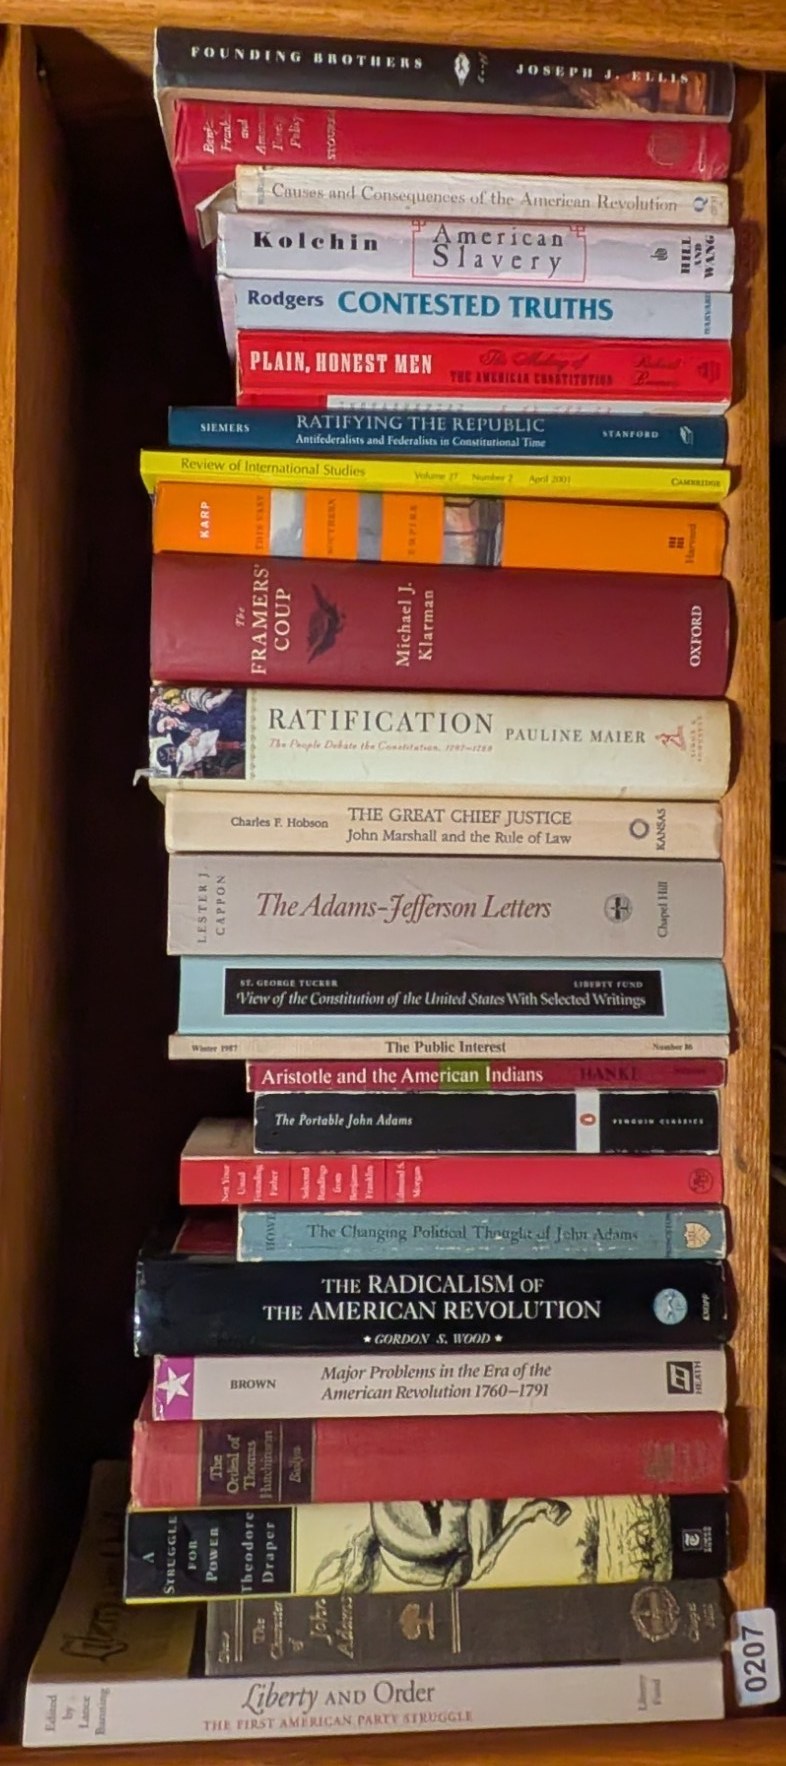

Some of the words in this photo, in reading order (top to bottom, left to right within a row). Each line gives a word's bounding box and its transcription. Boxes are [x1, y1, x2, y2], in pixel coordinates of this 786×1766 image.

[191, 47, 301, 63] FOUNDING
[313, 52, 423, 69] BROTHERS
[516, 64, 593, 79] JOSEPH
[604, 68, 620, 79] J.
[632, 71, 689, 84] ELLIS
[272, 183, 324, 199] Causes
[328, 179, 355, 199] and
[361, 184, 465, 205] Consequences
[470, 191, 487, 205] of
[491, 191, 514, 206] the
[519, 192, 590, 208] American
[597, 194, 677, 212] Revolution
[253, 231, 378, 251] Kolchin
[432, 223, 563, 247] American
[432, 244, 561, 278] Slavery
[680, 236, 691, 274] HILL
[704, 235, 715, 279] WANG
[247, 290, 324, 310] Rodgers
[338, 291, 500, 317] CONTESTED
[509, 295, 613, 321] TRUTHS
[250, 351, 310, 374] PLAIN,
[316, 352, 388, 373] HONEST
[395, 354, 432, 374] MEN
[450, 371, 471, 383] THE
[476, 372, 529, 384] AMERICAN
[534, 373, 613, 386] CONSTITUTION
[200, 423, 250, 433] SIEMERS
[297, 415, 402, 431] RATIFYING
[407, 416, 446, 431] THE
[452, 417, 545, 433] REPUBLIC
[602, 430, 659, 439] STANFORD
[296, 434, 364, 445] Antifederalists
[367, 435, 385, 446] and
[387, 435, 438, 446] Federalists
[440, 436, 450, 446] in
[452, 436, 520, 447] Constitutional
[522, 437, 546, 448] Time
[181, 458, 224, 471] Review
[229, 459, 242, 472] of
[244, 460, 320, 476] International
[323, 463, 366, 477] Studies
[200, 501, 211, 539] KARP
[398, 582, 415, 594] J.
[236, 606, 245, 628] The
[274, 588, 290, 652] COUP
[418, 590, 434, 661] Klarman
[396, 596, 411, 667] Michael
[689, 605, 702, 667] OXFORD
[269, 708, 493, 734] RATIFICATION
[505, 728, 583, 742] PAULINE
[590, 730, 646, 744] MAIER
[231, 817, 270, 828] Charles
[274, 818, 283, 828] F.
[287, 818, 329, 829] Hobson
[347, 807, 382, 822] THE
[388, 808, 445, 823] GREAT
[451, 809, 501, 823] CHIEF
[504, 810, 572, 827] JUSTICE
[346, 830, 378, 843] John
[382, 830, 437, 842] Marshall
[441, 831, 466, 843] and
[470, 831, 490, 843] the
[495, 831, 523, 844] Rule
[527, 832, 543, 844] of
[546, 832, 572, 844] Law
[656, 808, 667, 851] KANSAS
[657, 881, 668, 900] Hill
[197, 885, 208, 943] LESTER
[215, 874, 226, 936] CAPPON
[257, 892, 298, 917] The
[300, 893, 477, 924] Adams-Jefferson
[482, 894, 552, 919] Letters
[657, 901, 668, 938] Chapel
[240, 980, 254, 988] ST.
[256, 980, 296, 988] GEORGE
[299, 980, 338, 988] TUCKER
[573, 980, 614, 989] LIBERTY
[616, 981, 643, 989] FUND
[236, 991, 270, 1004] View
[272, 991, 286, 1008] of
[289, 991, 307, 1005] the
[310, 992, 384, 1006] Constitution
[387, 992, 402, 1008] of
[403, 992, 422, 1006] the
[424, 992, 466, 1006] United
[467, 992, 505, 1006] States
[506, 992, 538, 1006] With
[540, 992, 590, 1006] Selected
[591, 993, 646, 1009] Writings
[191, 1045, 217, 1053] Winter
[385, 1041, 410, 1053] The
[414, 1040, 455, 1053] Public
[459, 1041, 506, 1053] Interest
[261, 1069, 332, 1085] Aristotle
[336, 1068, 366, 1085] and
[372, 1068, 397, 1084] the
[400, 1067, 479, 1084] American
[486, 1066, 543, 1083] Indians
[275, 1113, 295, 1126] The
[298, 1112, 344, 1127] Portable
[346, 1113, 373, 1129] John
[376, 1114, 413, 1126] Adams
[307, 1224, 336, 1238] The
[341, 1225, 408, 1242] Changing
[413, 1225, 467, 1239] Political
[472, 1225, 532, 1244] Thought
[553, 1226, 588, 1244] John
[593, 1227, 639, 1241] Adams
[322, 1278, 361, 1294] THE
[368, 1274, 513, 1294] RADICALISM
[520, 1278, 544, 1294] OF
[262, 1305, 302, 1321] THE
[308, 1301, 435, 1320] AMERICAN
[443, 1300, 601, 1320] REVOLUTION
[374, 1333, 430, 1345] GORDON
[436, 1333, 448, 1344] S.
[453, 1333, 491, 1344] WOOD
[321, 1366, 366, 1384] Major
[369, 1364, 437, 1380] Problems
[440, 1364, 454, 1378] in
[457, 1364, 480, 1378] the
[483, 1364, 510, 1378] Era
[512, 1362, 531, 1381] of
[533, 1362, 552, 1377] the
[230, 1379, 276, 1390] BROWN
[321, 1386, 392, 1400] American
[395, 1384, 471, 1400] Revolution
[227, 1433, 241, 1450] of
[209, 1454, 223, 1481] The
[226, 1452, 240, 1494] Ordeal
[243, 1440, 256, 1491] Thomas
[259, 1430, 273, 1499] Hutchinson
[142, 1552, 155, 1564] A
[163, 1515, 178, 1594] STRUGGLE
[188, 1540, 198, 1570] FOR
[206, 1527, 219, 1582] POWER
[241, 1512, 255, 1593] Theodore
[262, 1521, 276, 1583] Draper
[741, 1625, 767, 1693] 0207
[242, 1682, 318, 1715] Liberty
[325, 1689, 366, 1706] AND
[373, 1680, 436, 1702] Order
[204, 1720, 231, 1731] THE
[237, 1718, 276, 1730] FIRST
[279, 1716, 352, 1729] AMERICAN
[357, 1713, 399, 1726] PARTY
[403, 1711, 473, 1724] STRUGGLE
